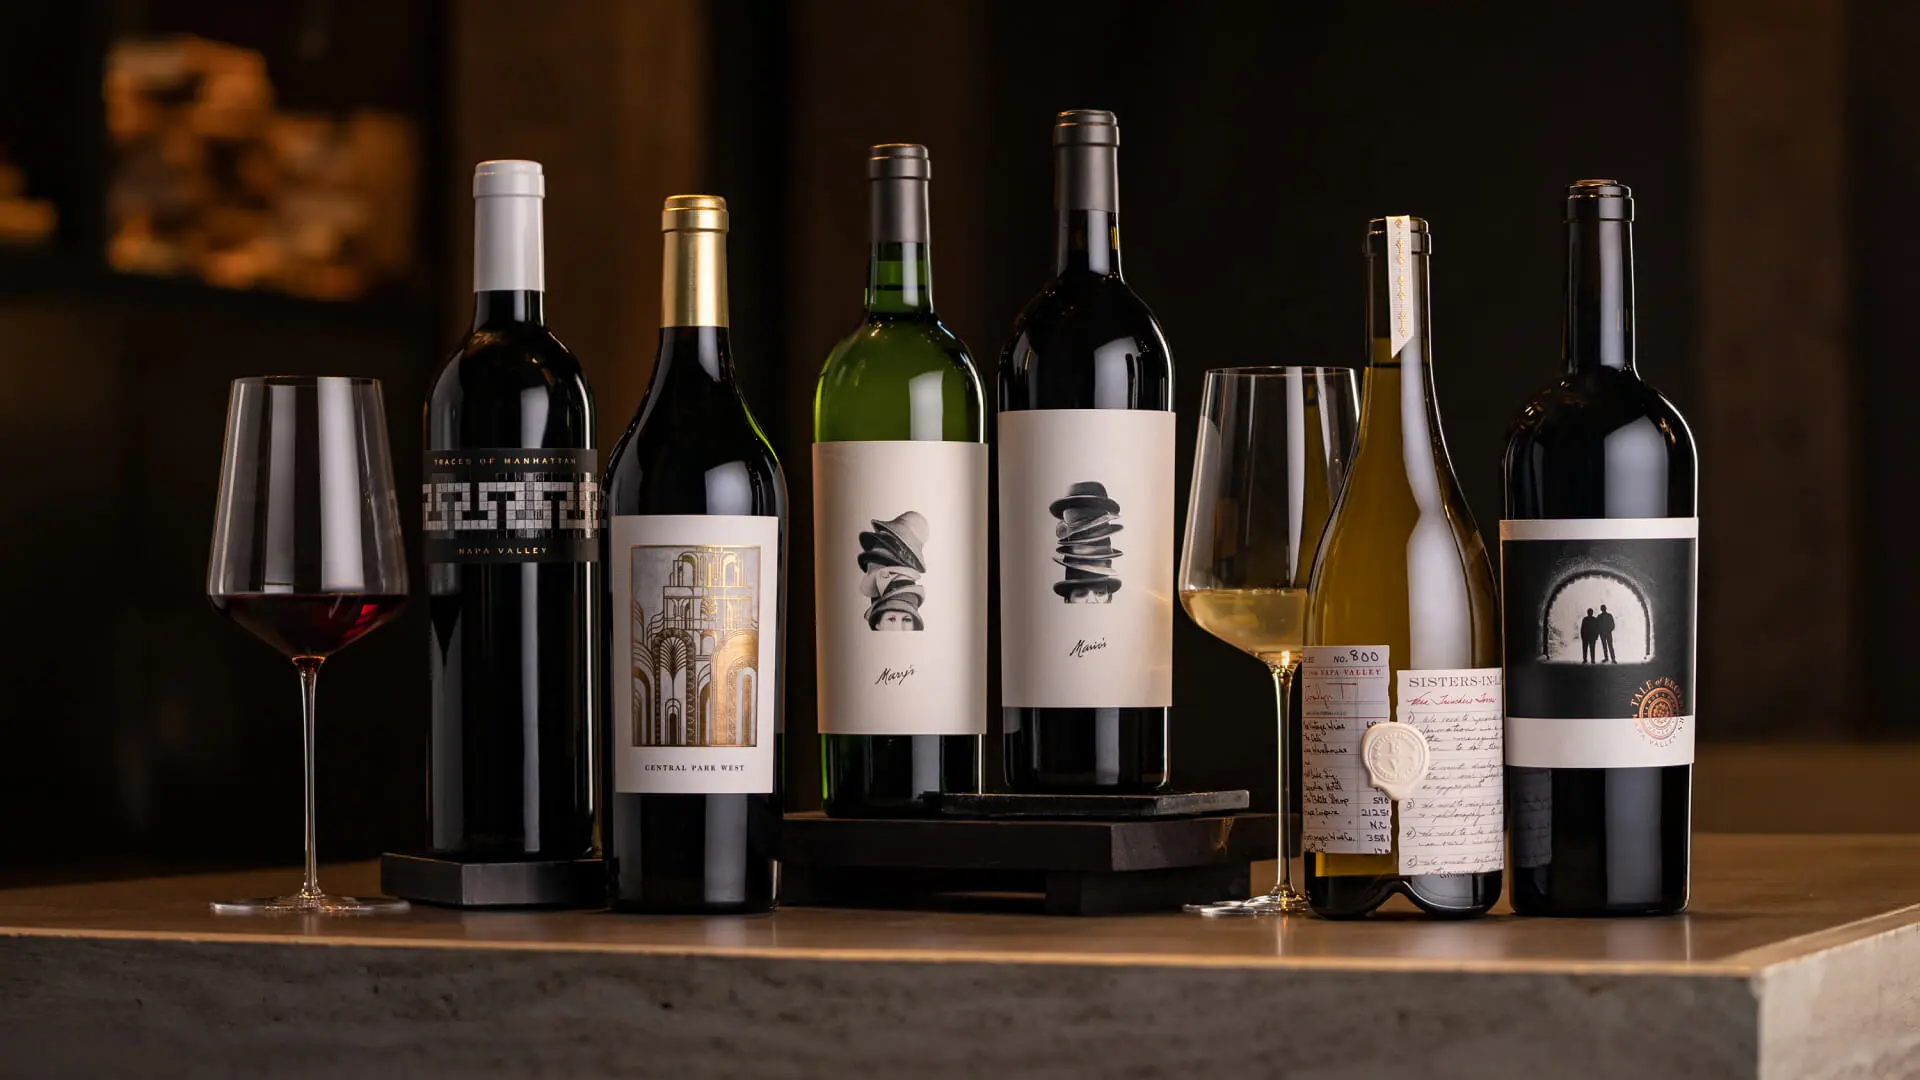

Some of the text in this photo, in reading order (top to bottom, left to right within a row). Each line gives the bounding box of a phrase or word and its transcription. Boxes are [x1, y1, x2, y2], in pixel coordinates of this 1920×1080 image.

[1333, 649, 1379, 663] NO. 800
[1343, 668, 1381, 677] VALLEY
[644, 764, 745, 772] CENTRAL PARK WEST
